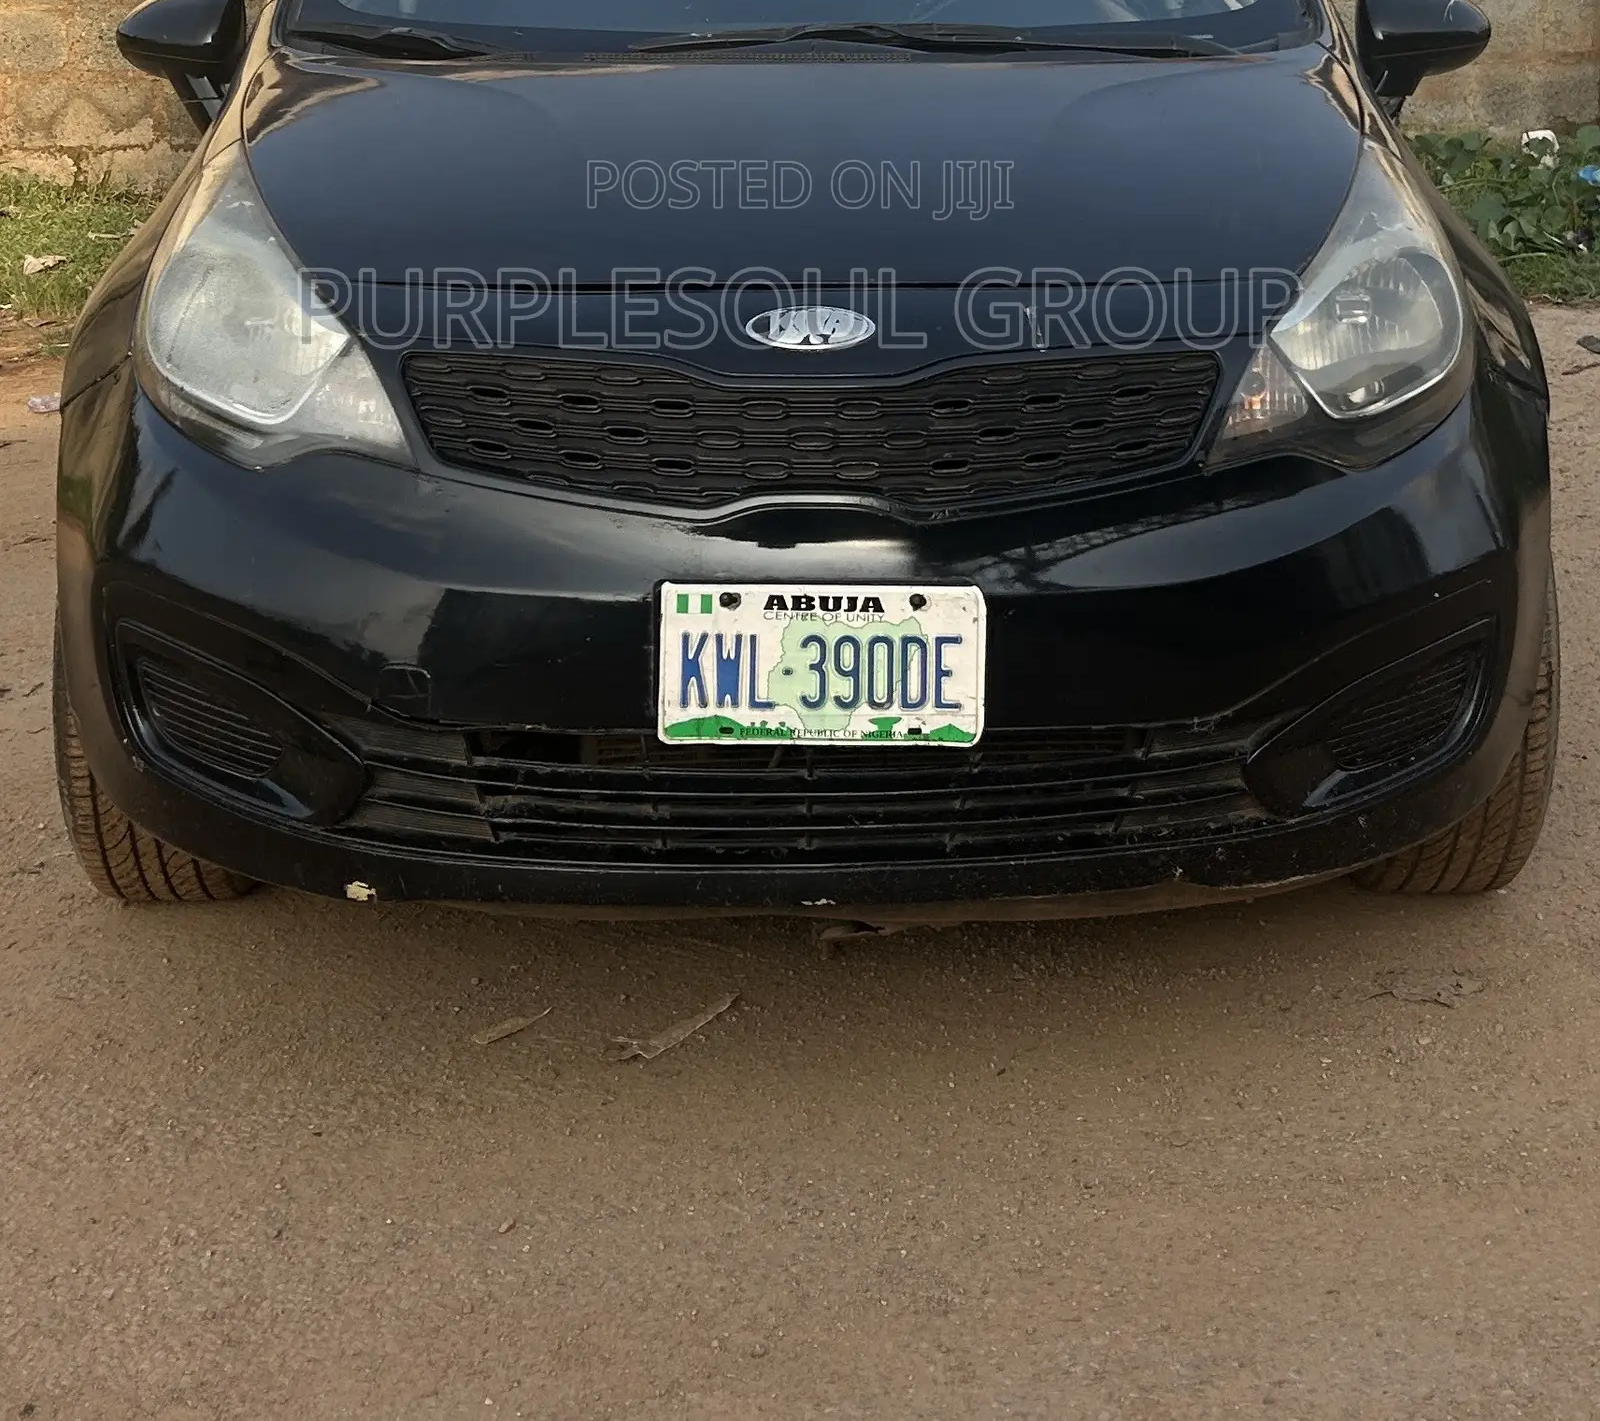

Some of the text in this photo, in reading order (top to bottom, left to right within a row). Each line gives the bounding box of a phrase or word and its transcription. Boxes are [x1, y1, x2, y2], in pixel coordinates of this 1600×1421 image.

[763, 594, 885, 613] ABUJA
[763, 611, 885, 623] CENTRE OF UNITY
[739, 726, 904, 739] FEDERAL REPUBLIC OF NIGERIA
